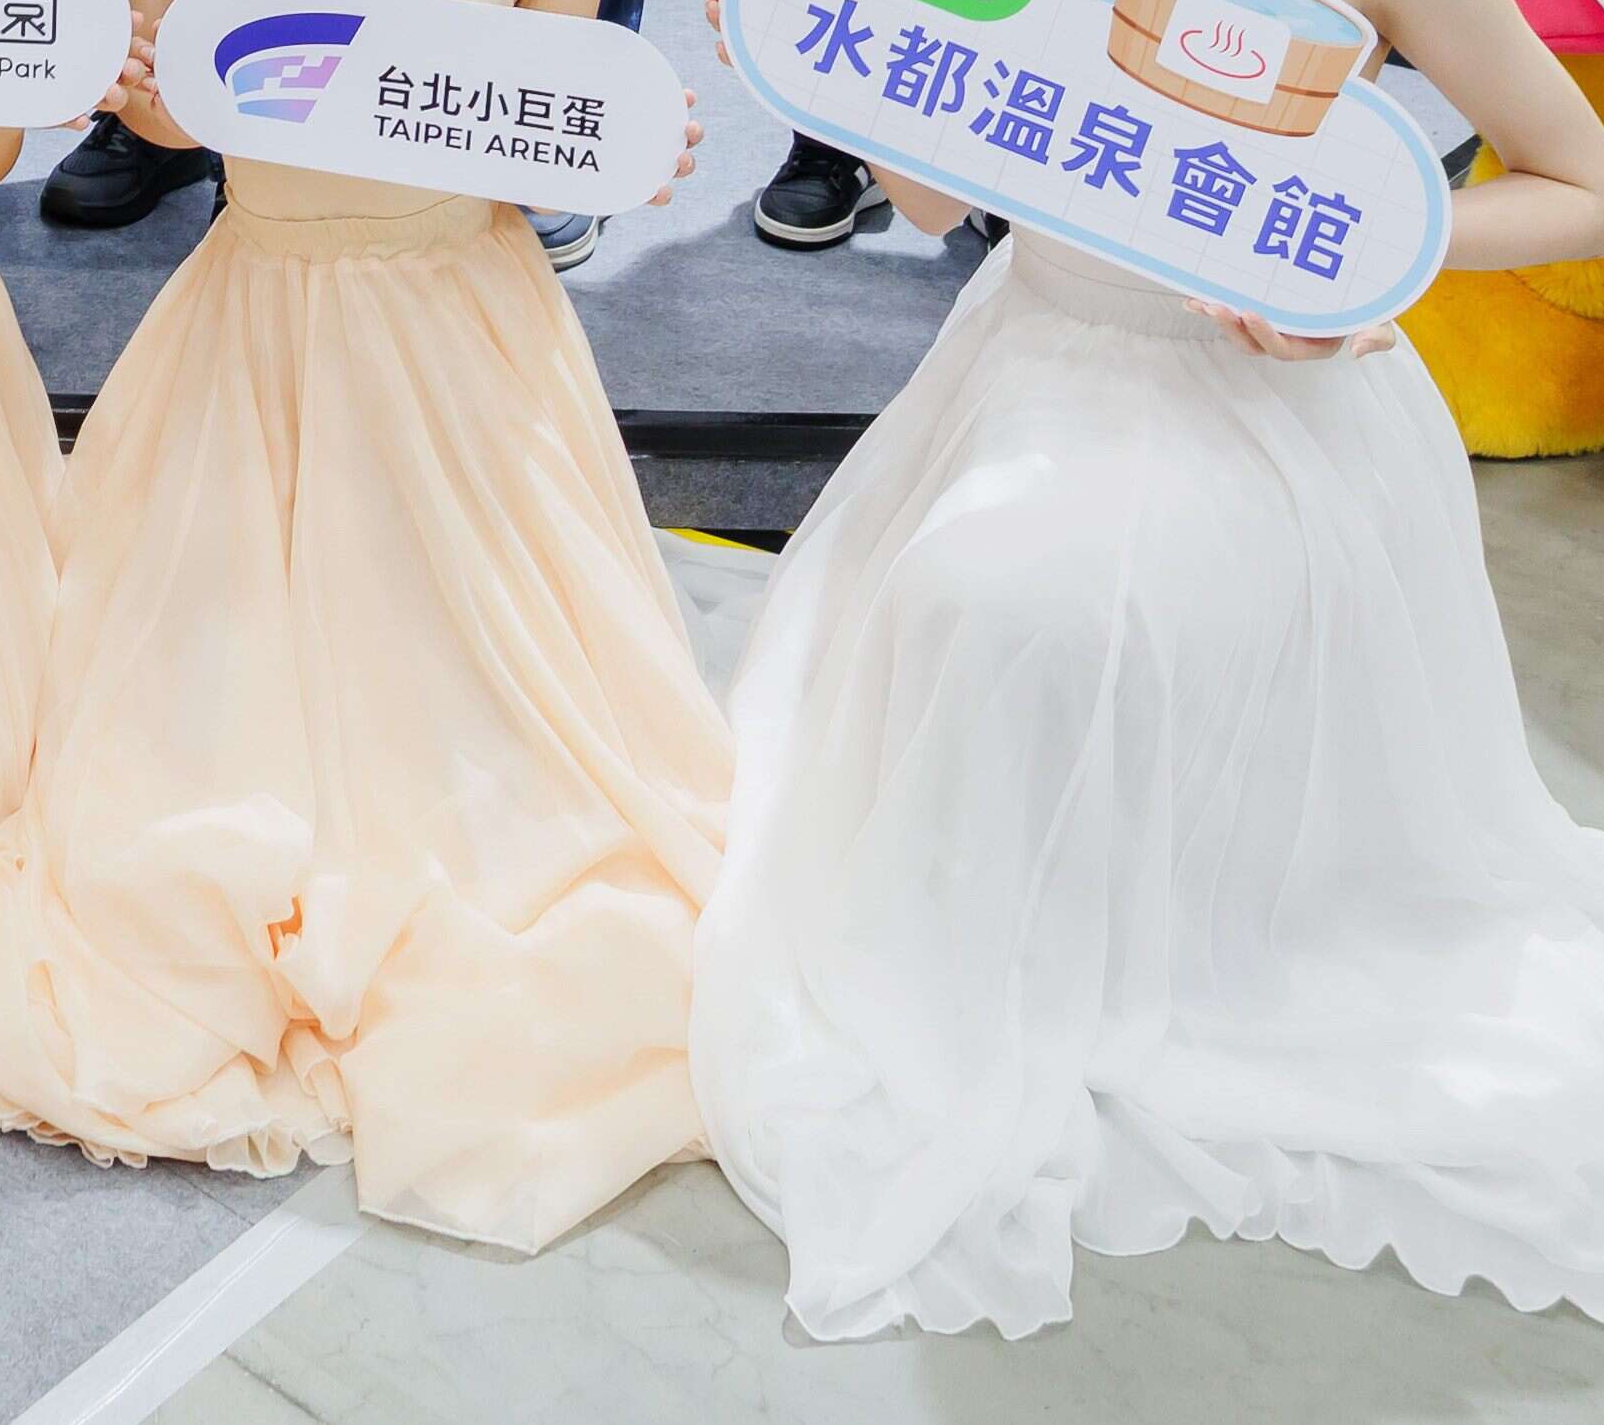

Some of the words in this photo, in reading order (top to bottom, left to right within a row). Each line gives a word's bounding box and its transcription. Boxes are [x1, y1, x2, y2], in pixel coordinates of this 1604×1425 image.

[374, 64, 607, 143] 台北小巨蛋
[372, 111, 474, 154] TAIPEI
[482, 131, 602, 174] ARENA
